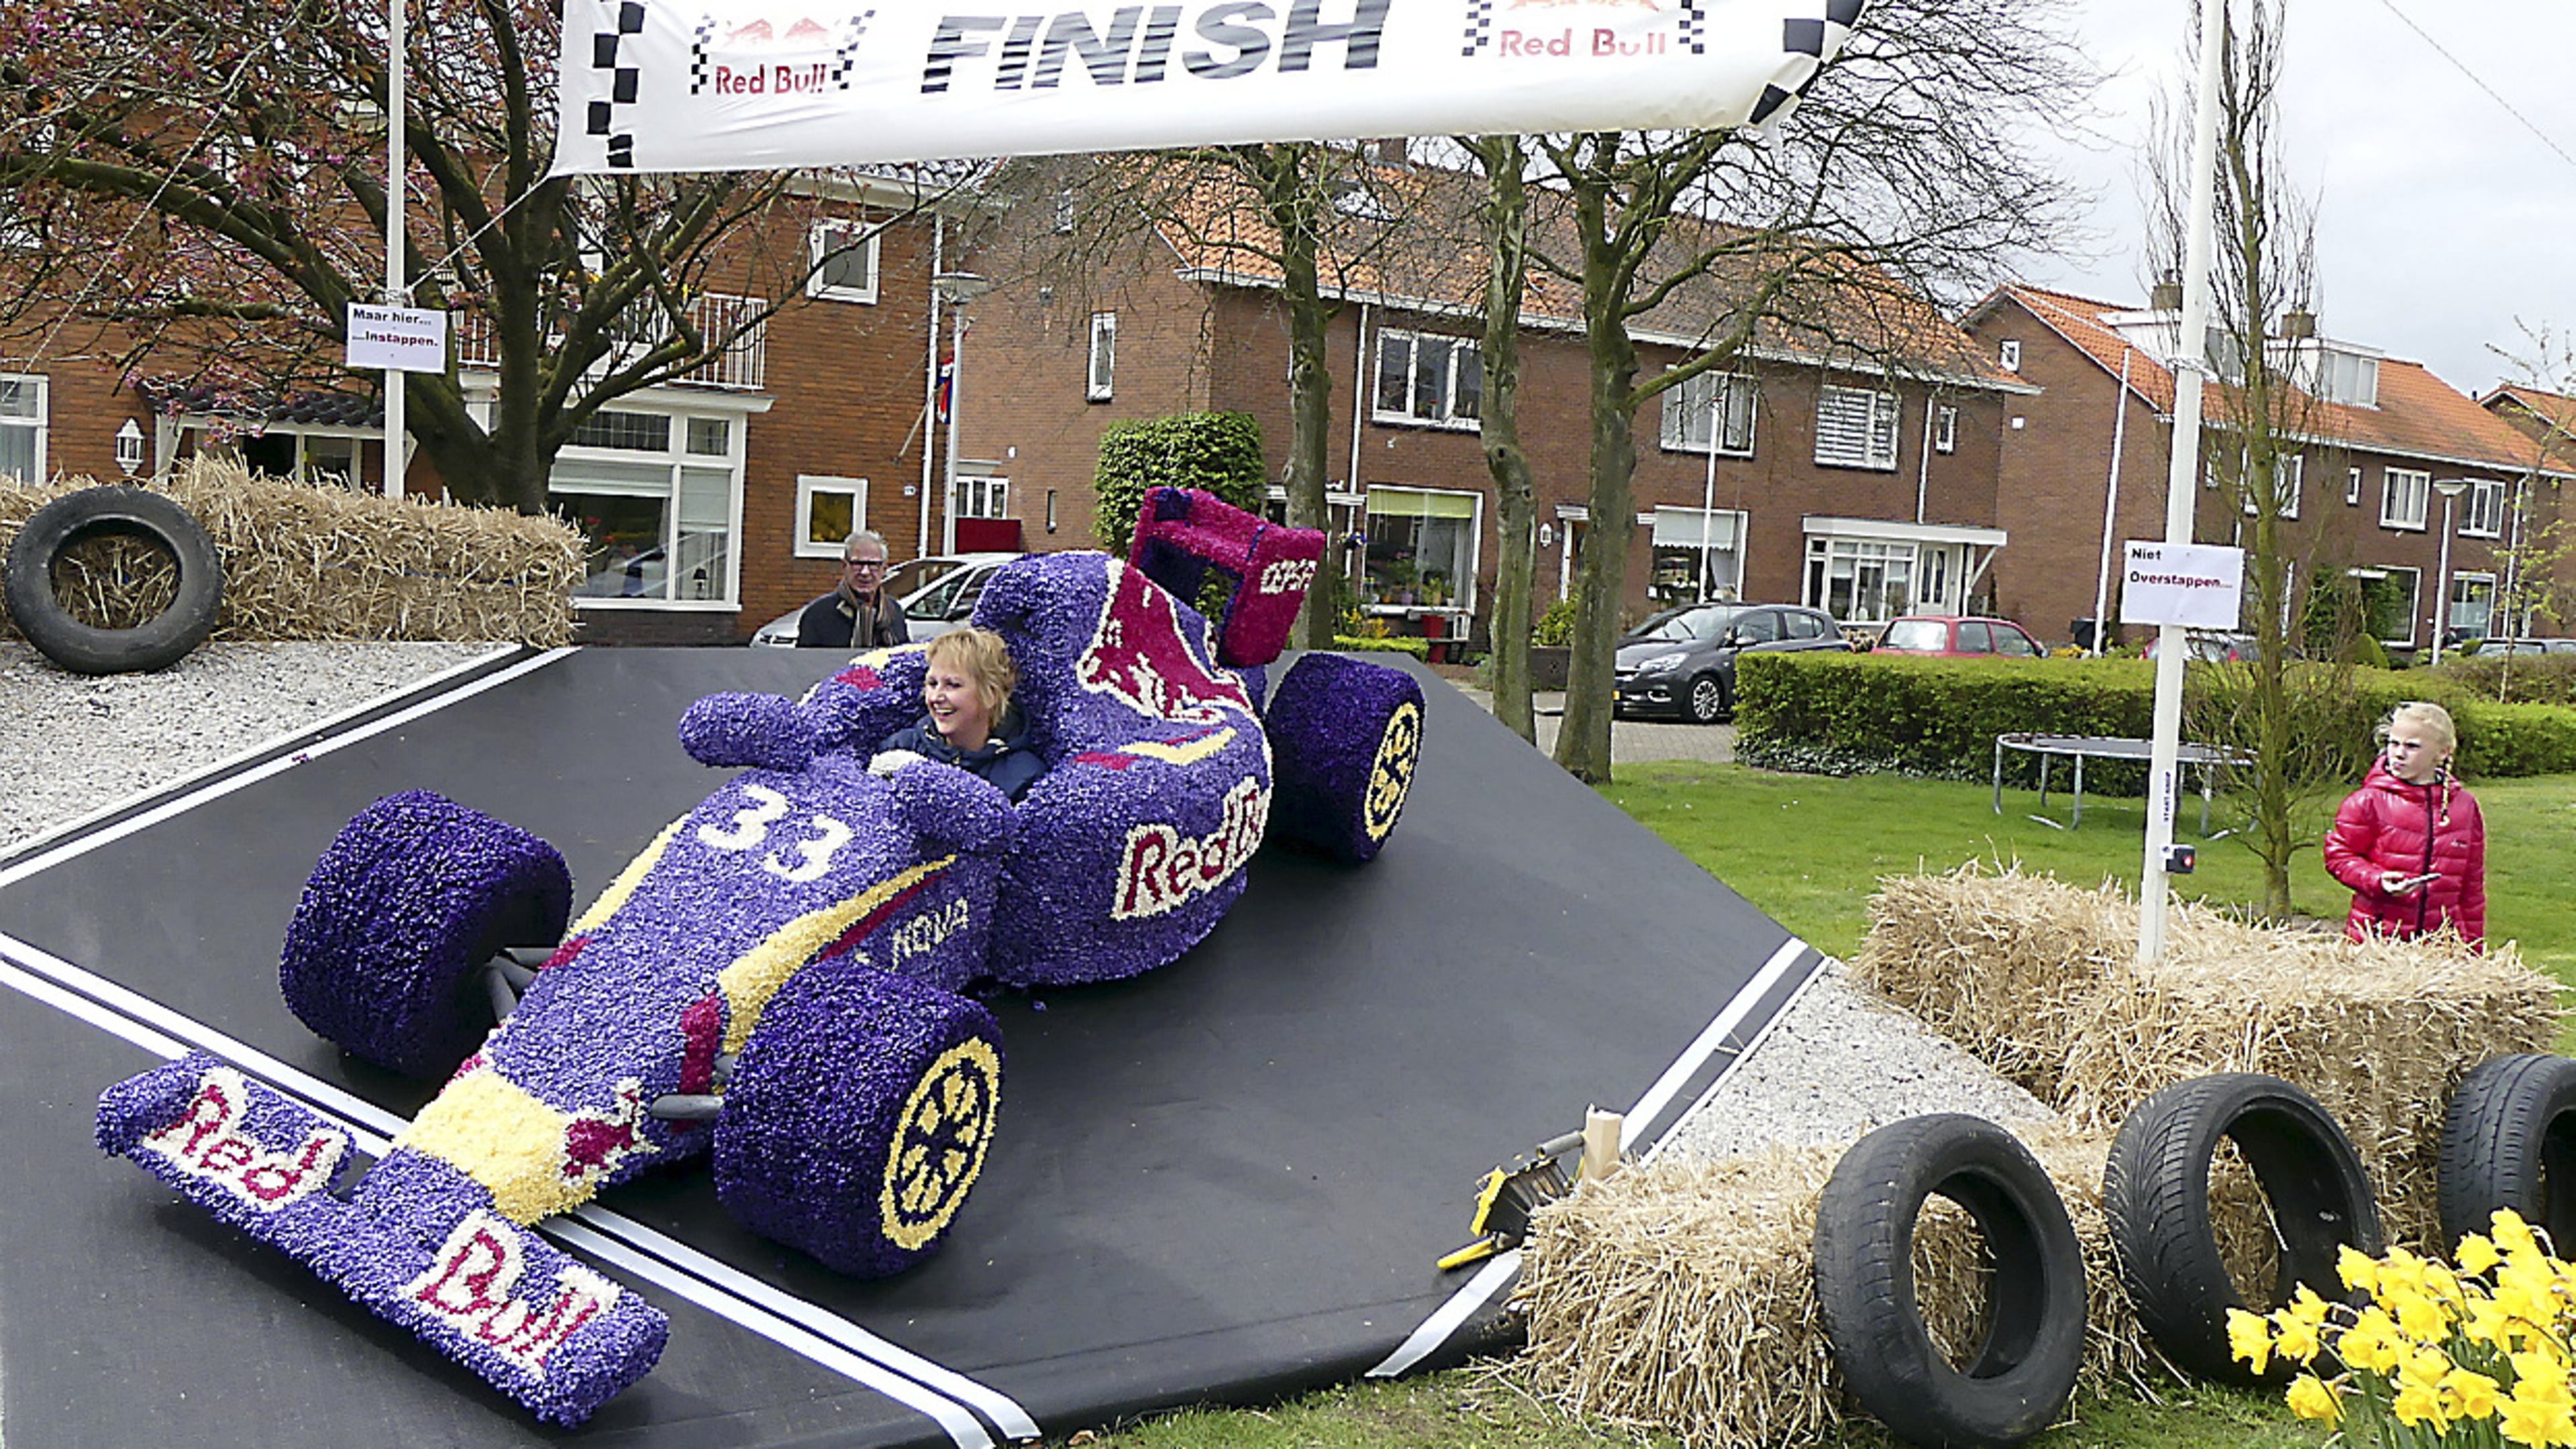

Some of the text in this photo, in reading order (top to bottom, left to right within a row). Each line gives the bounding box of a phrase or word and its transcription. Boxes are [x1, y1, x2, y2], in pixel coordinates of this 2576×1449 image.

[921, 0, 1391, 93] FINISH
[1499, 28, 1665, 56] Red Bull
[716, 64, 764, 94] Red
[353, 309, 388, 321] Maar
[2131, 548, 2161, 560] Niet
[698, 784, 855, 883] 33
[150, 1083, 333, 1201] Red
[415, 1227, 601, 1366] Bull
